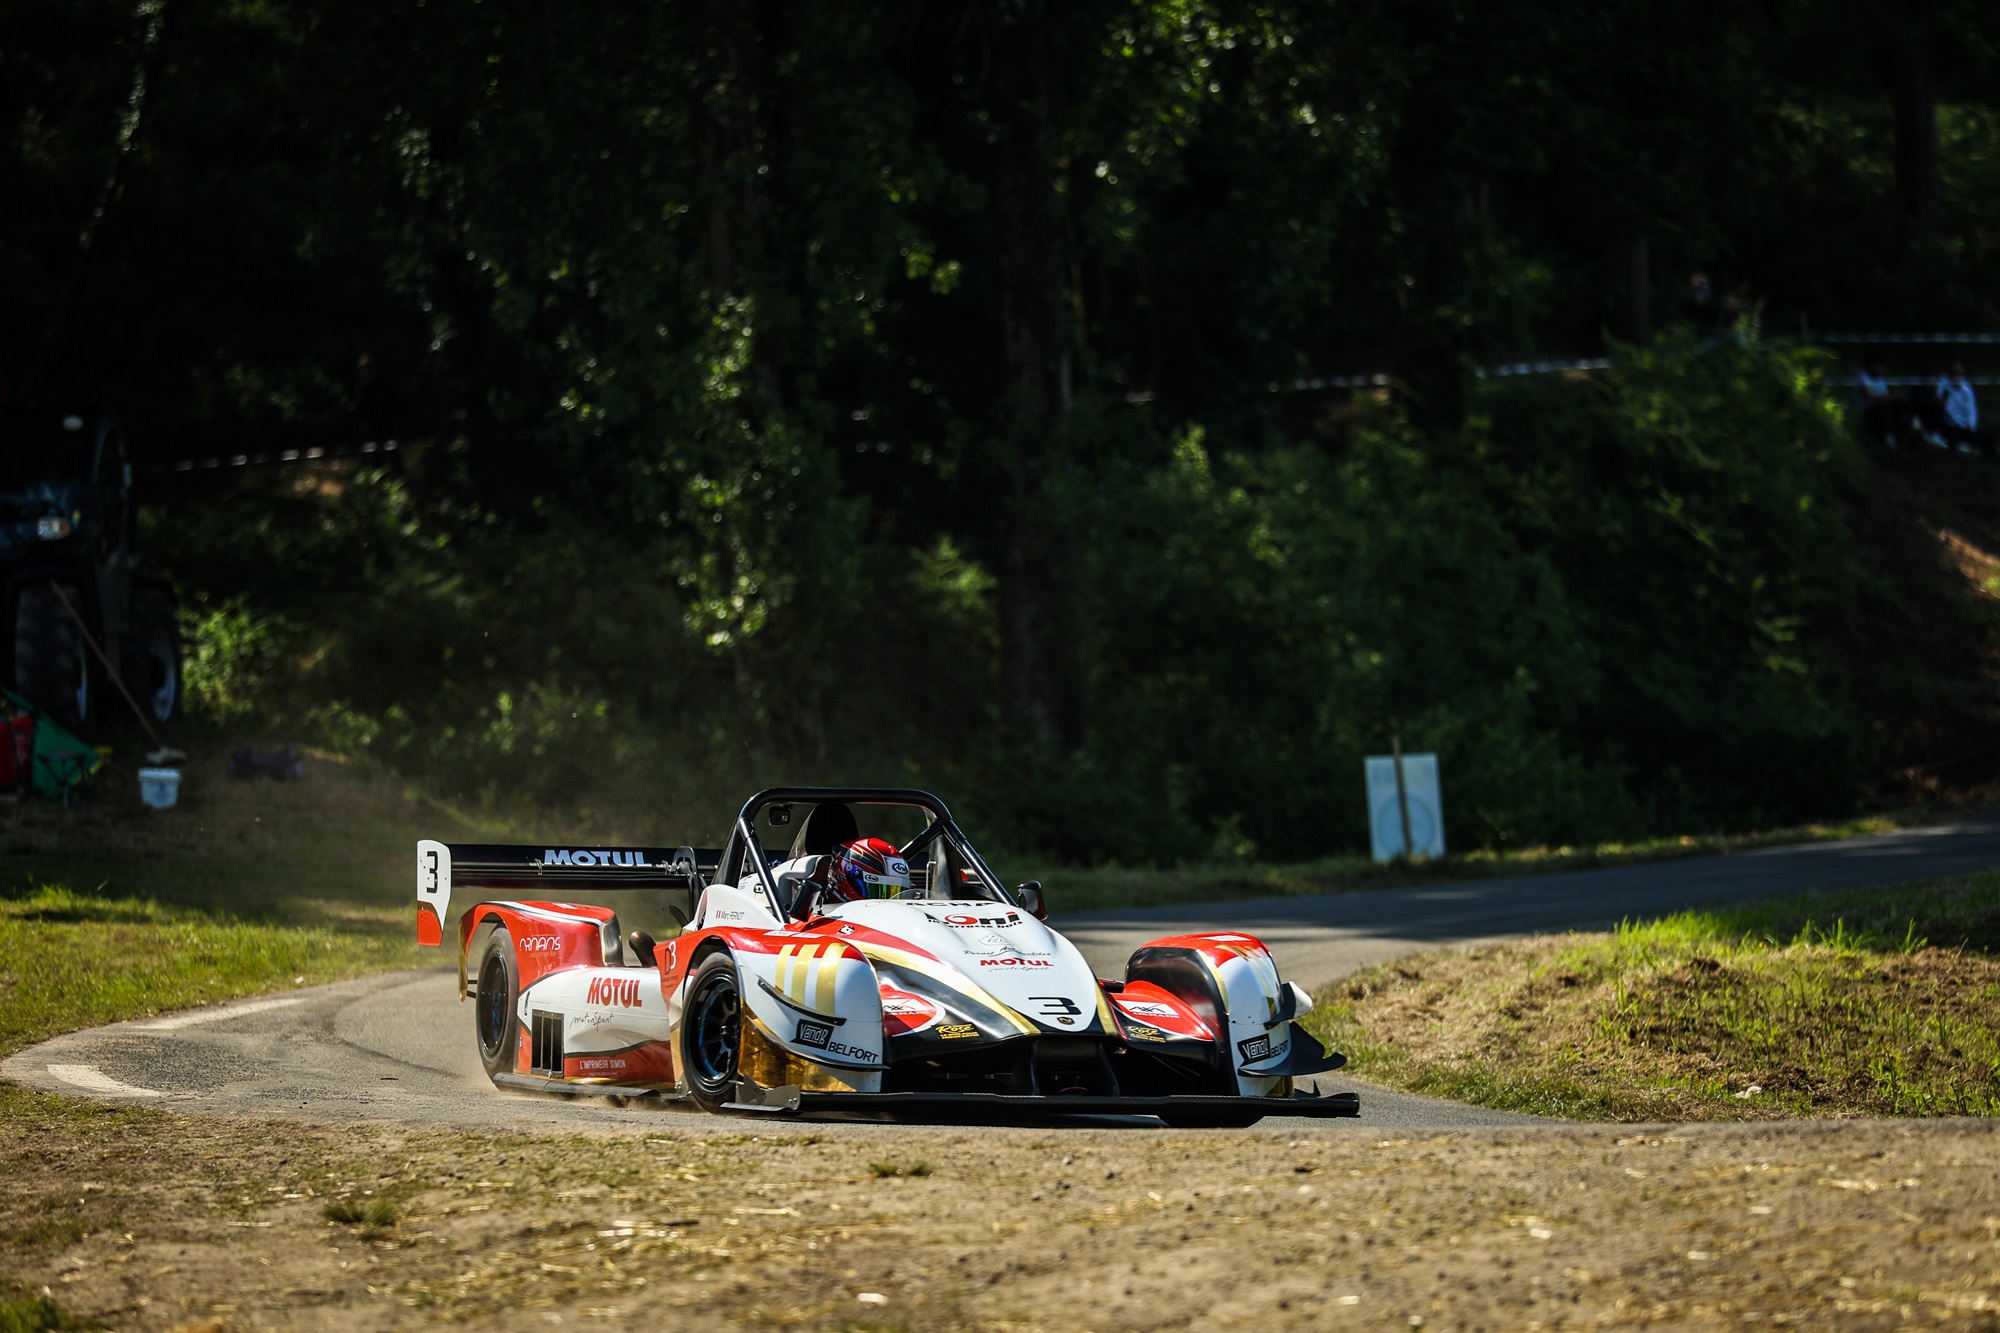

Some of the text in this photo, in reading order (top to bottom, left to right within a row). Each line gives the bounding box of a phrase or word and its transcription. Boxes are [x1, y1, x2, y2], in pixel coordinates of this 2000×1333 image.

[543, 849, 652, 867] MOTUL
[426, 850, 438, 894] 3
[980, 957, 1054, 967] MOTUL
[586, 976, 643, 1009] MOTUL
[1028, 996, 1083, 1015] 3
[827, 1040, 879, 1064] BELFORT
